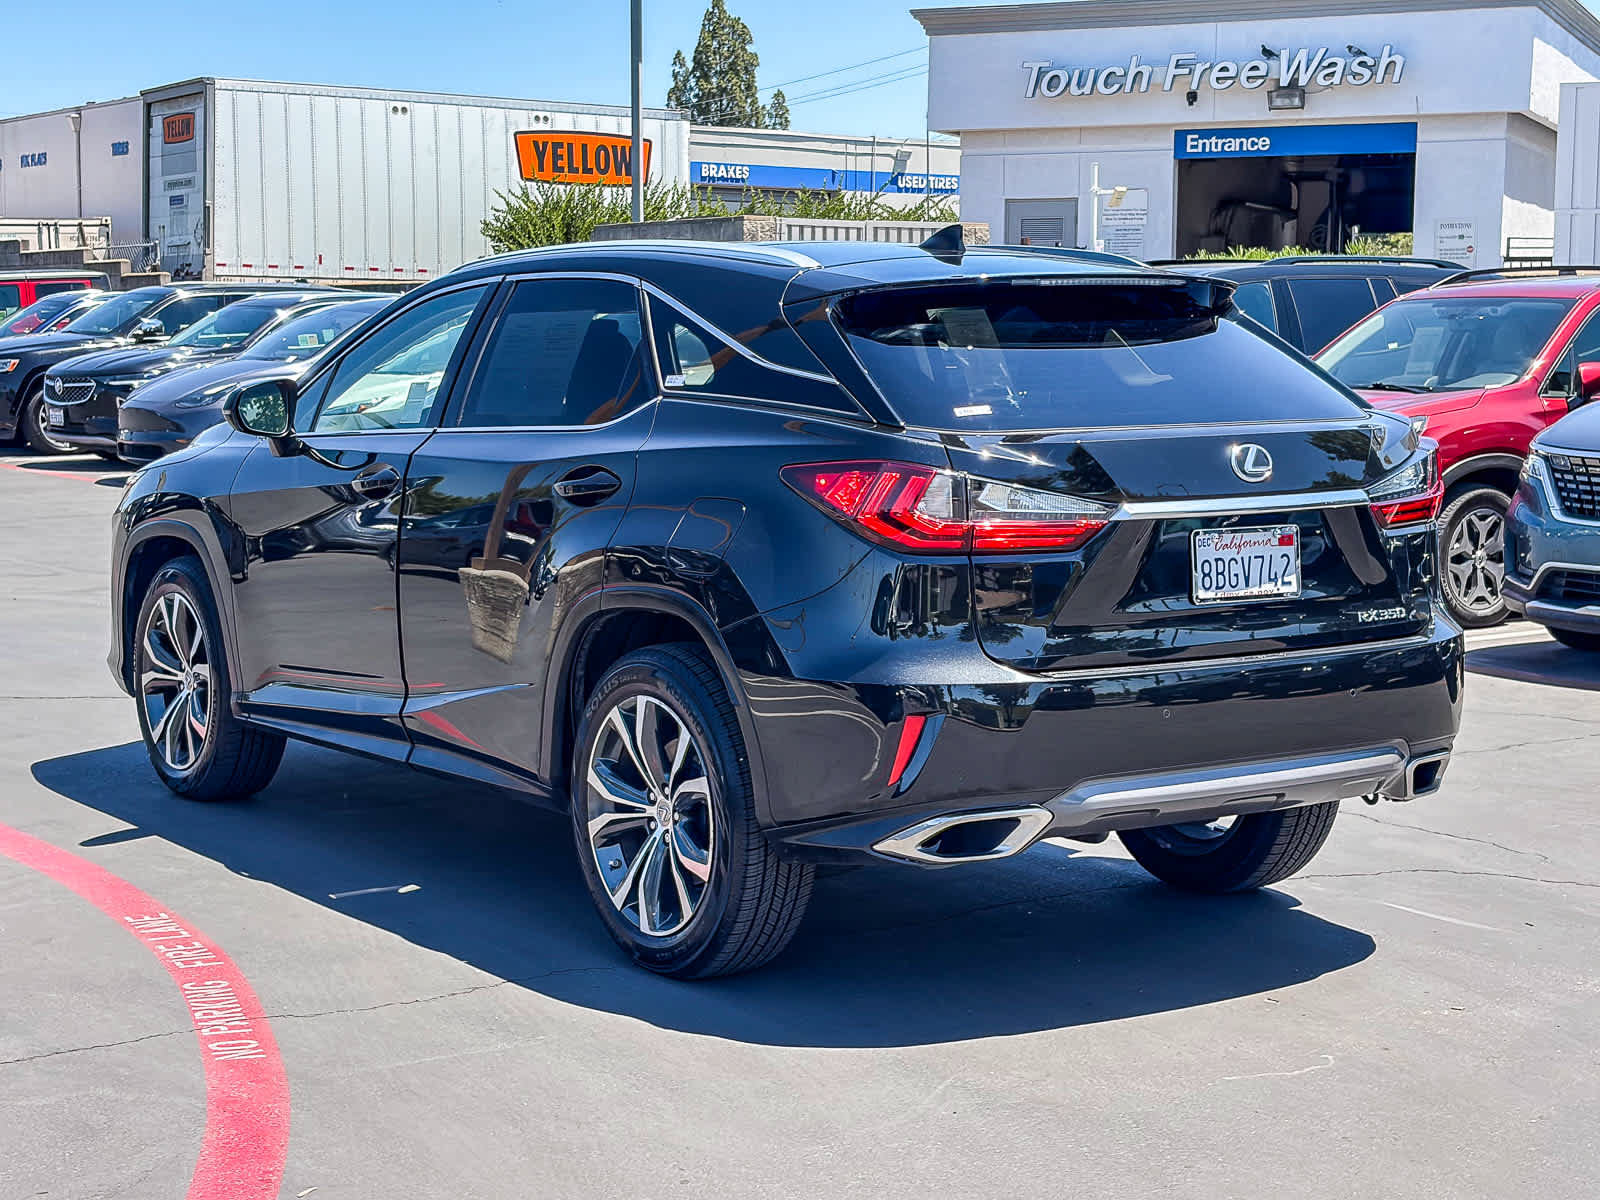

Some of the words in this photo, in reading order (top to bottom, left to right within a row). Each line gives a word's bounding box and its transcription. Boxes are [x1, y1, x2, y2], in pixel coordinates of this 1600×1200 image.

[1022, 55, 1153, 99] Touch
[1162, 51, 1269, 92] Free
[1278, 44, 1406, 88] Wash
[167, 118, 191, 138] YELLOW
[1185, 134, 1271, 154] Entrance
[532, 139, 633, 177] YELLOW
[700, 163, 750, 180] BRAKES
[897, 175, 927, 189] USED
[928, 176, 959, 190] TIRES
[1213, 533, 1272, 555] California
[1200, 553, 1293, 592] 8BGV742
[155, 941, 225, 969] FIRE
[182, 979, 253, 1036] PARKING
[207, 1039, 267, 1061] NO
